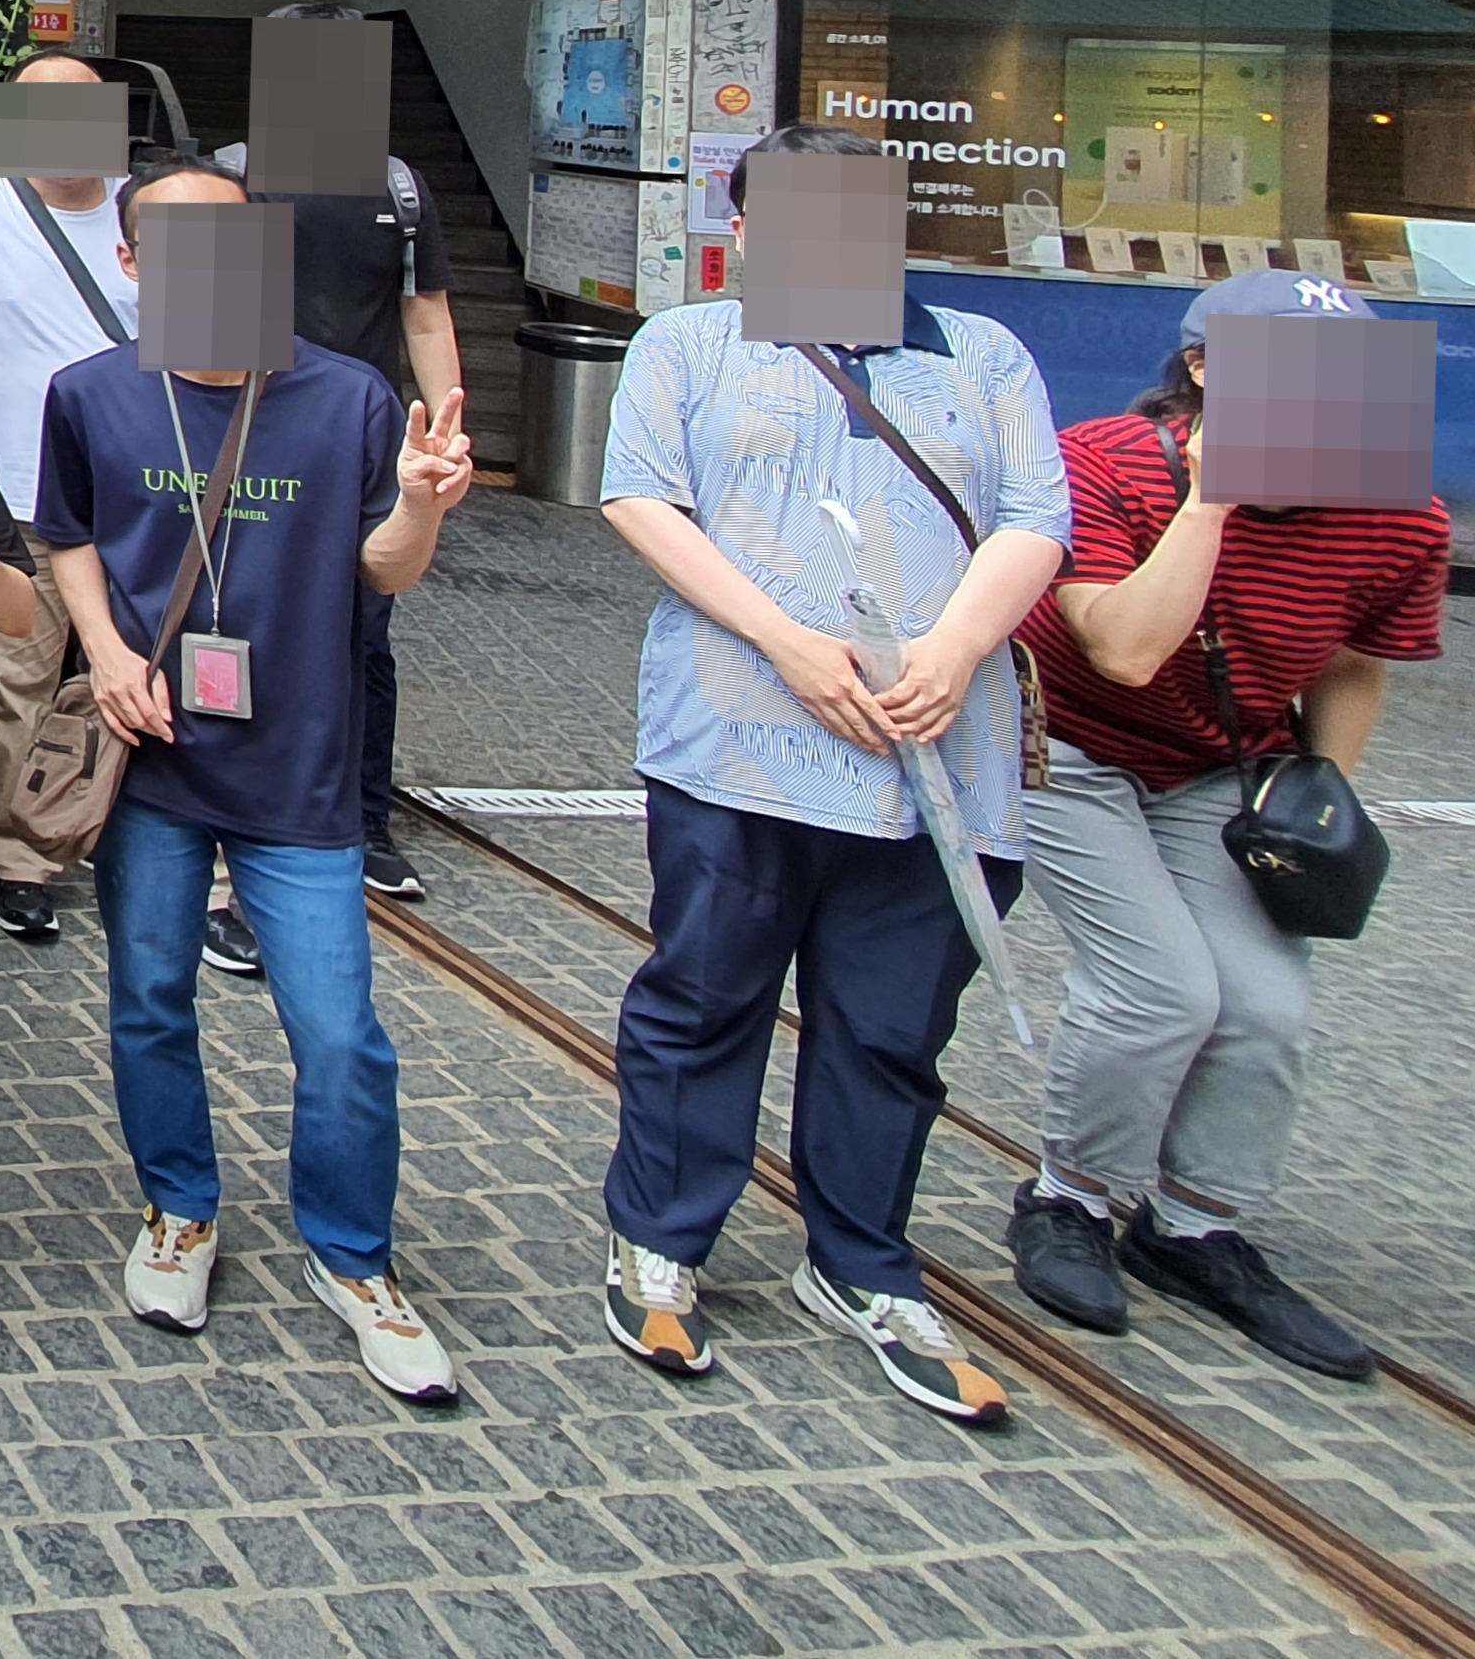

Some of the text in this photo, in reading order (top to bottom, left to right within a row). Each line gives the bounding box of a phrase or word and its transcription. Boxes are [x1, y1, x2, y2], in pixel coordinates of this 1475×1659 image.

[824, 90, 973, 123] Human
[880, 138, 1066, 169] nnection
[141, 467, 209, 494] UNE
[218, 508, 270, 522] OMMEIL
